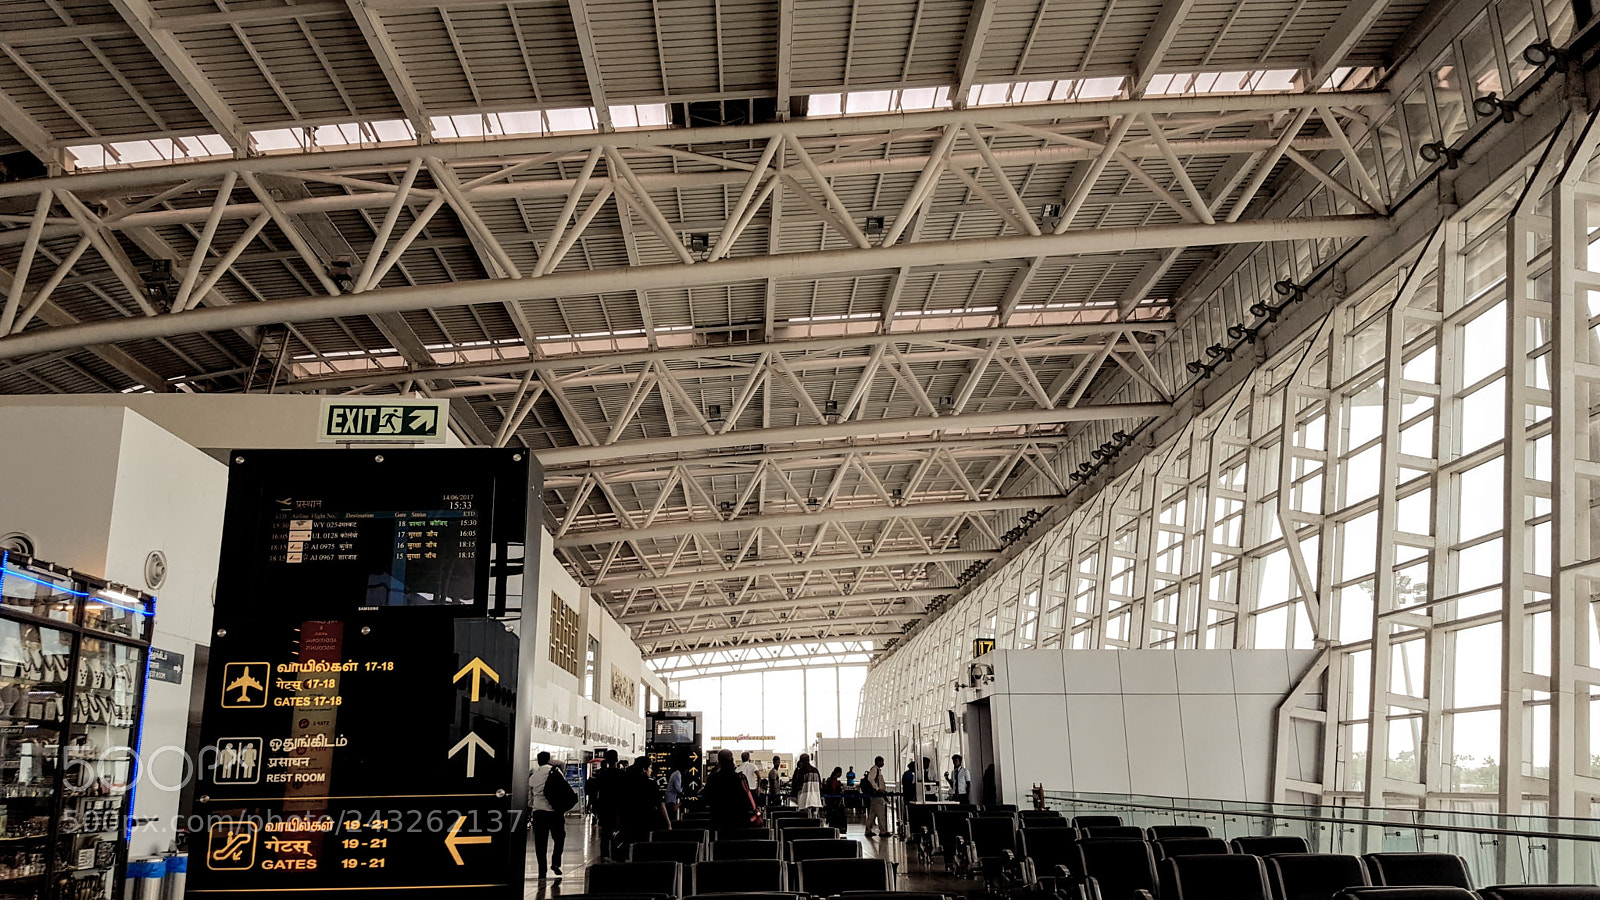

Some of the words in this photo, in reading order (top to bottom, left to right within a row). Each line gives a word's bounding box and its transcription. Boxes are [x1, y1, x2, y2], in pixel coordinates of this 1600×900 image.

[331, 408, 377, 433] EXIT
[296, 500, 322, 508] प्रस्थान
[450, 502, 472, 510] 15:33
[979, 640, 993, 655] 17
[277, 659, 358, 673] வாயில்கள்
[364, 662, 394, 671] 17-18
[307, 679, 336, 688] 17-18
[274, 697, 310, 707] GATES
[313, 696, 342, 706] 17-18
[269, 734, 348, 752] ஒதுங்கிடம்
[267, 757, 310, 768] प्रसाधन
[266, 774, 293, 783] REST
[295, 773, 326, 782] ROOM
[265, 817, 335, 832] வாயில்கள்
[264, 836, 312, 856] गेटस्
[261, 859, 318, 870] GATES
